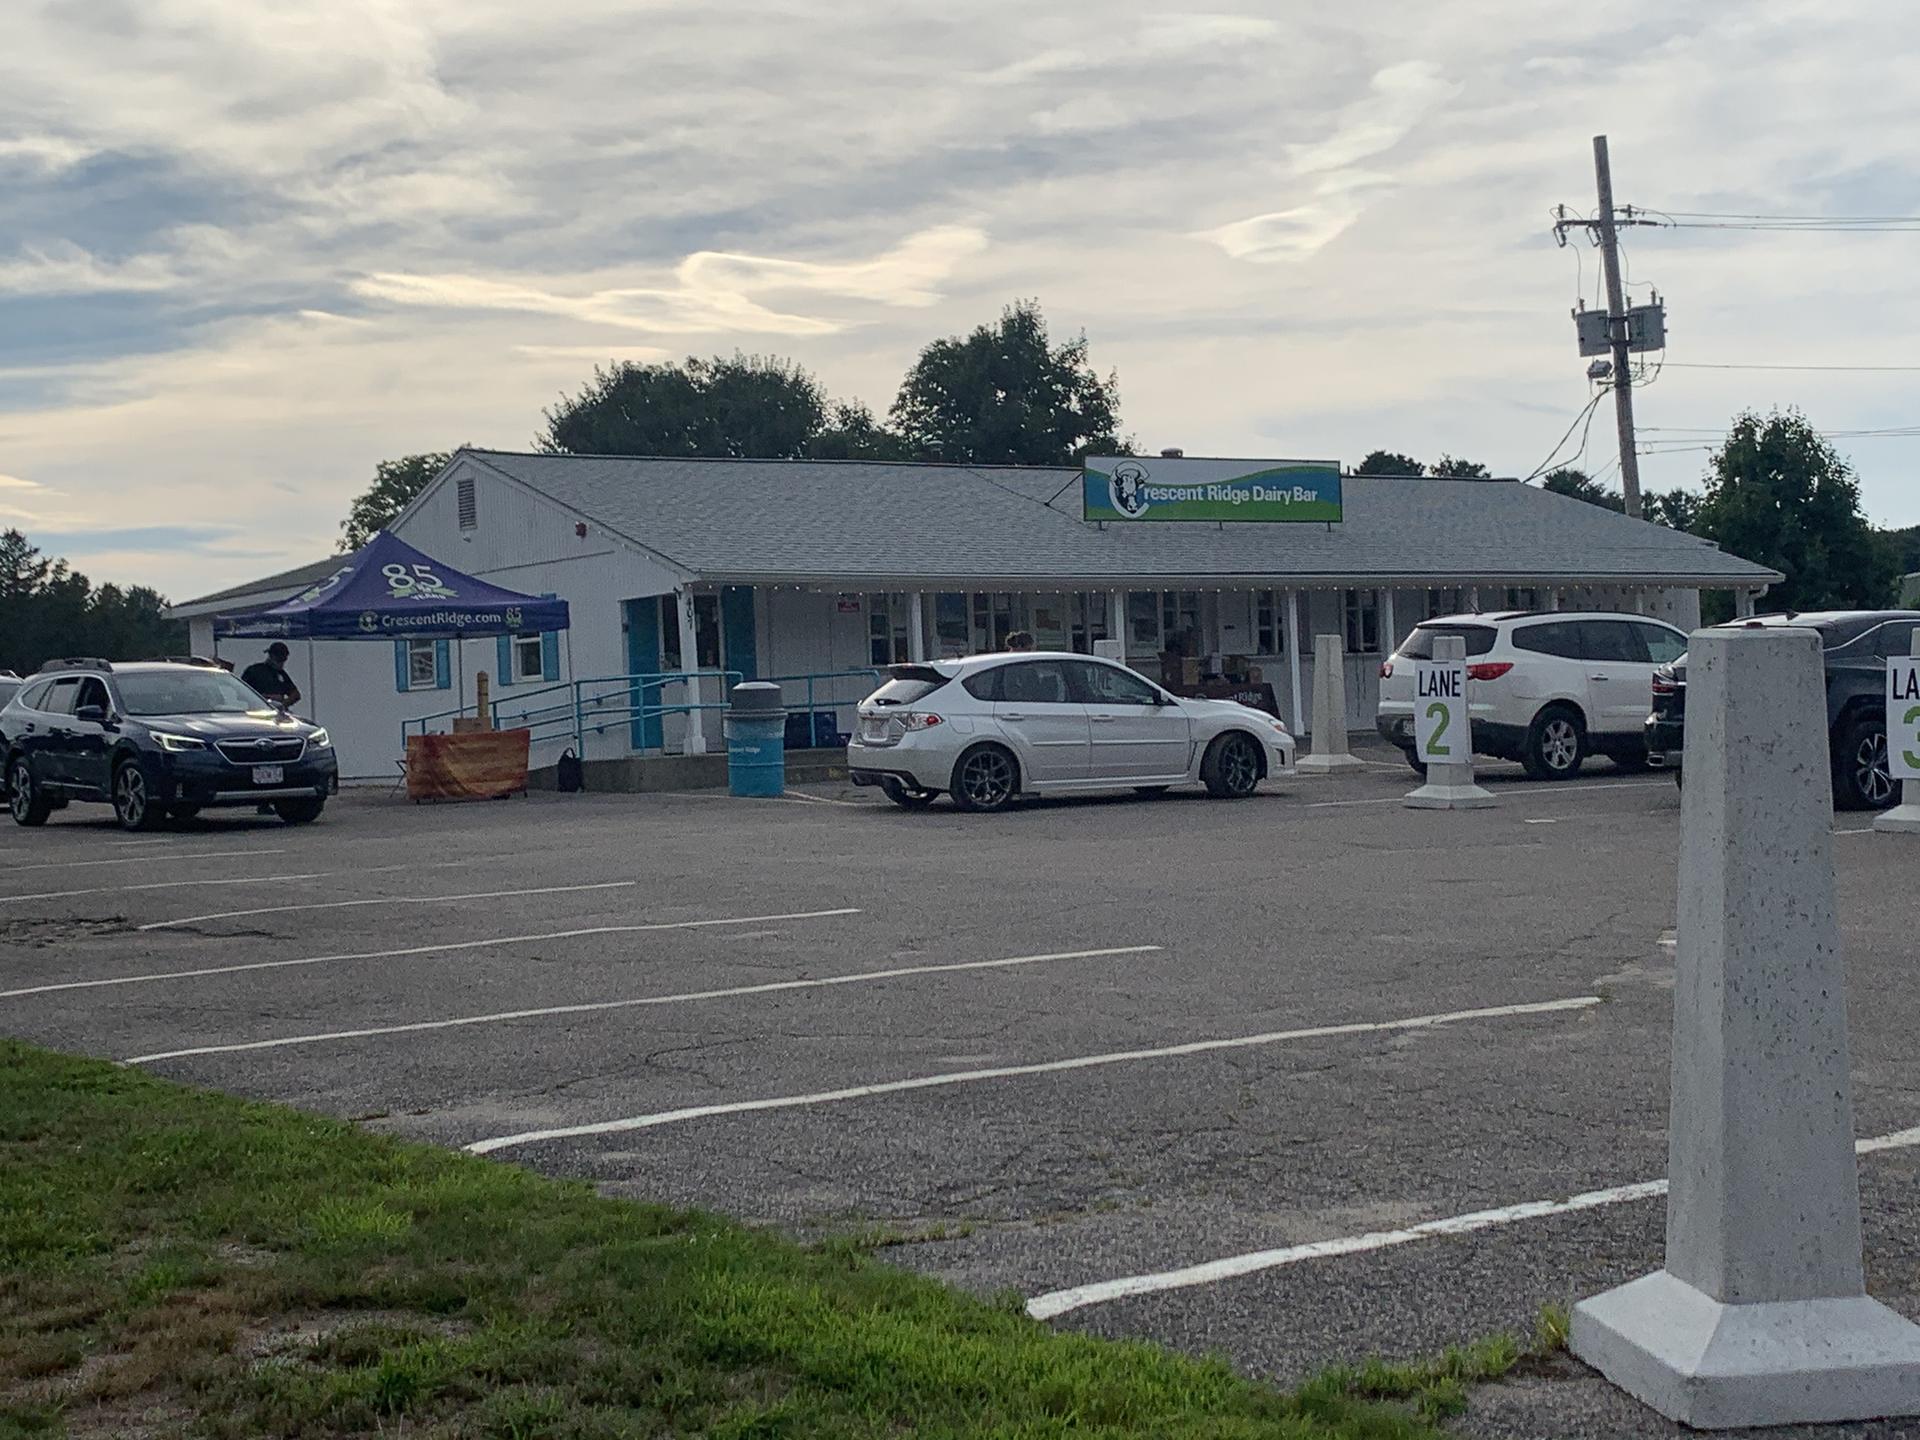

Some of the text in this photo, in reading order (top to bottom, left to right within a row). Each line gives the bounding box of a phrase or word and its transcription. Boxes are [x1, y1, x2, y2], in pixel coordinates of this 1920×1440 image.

[1207, 485, 1250, 505] Ridge
[1253, 486, 1292, 505] Dairy
[1294, 486, 1318, 502] Bar
[381, 563, 444, 589] 85
[382, 611, 502, 628] CrescentRidge.com
[505, 607, 522, 620] 85
[1418, 669, 1461, 697] LANE
[1892, 668, 1920, 700] LA
[1425, 701, 1450, 756] 2
[1902, 705, 1920, 769] 3
